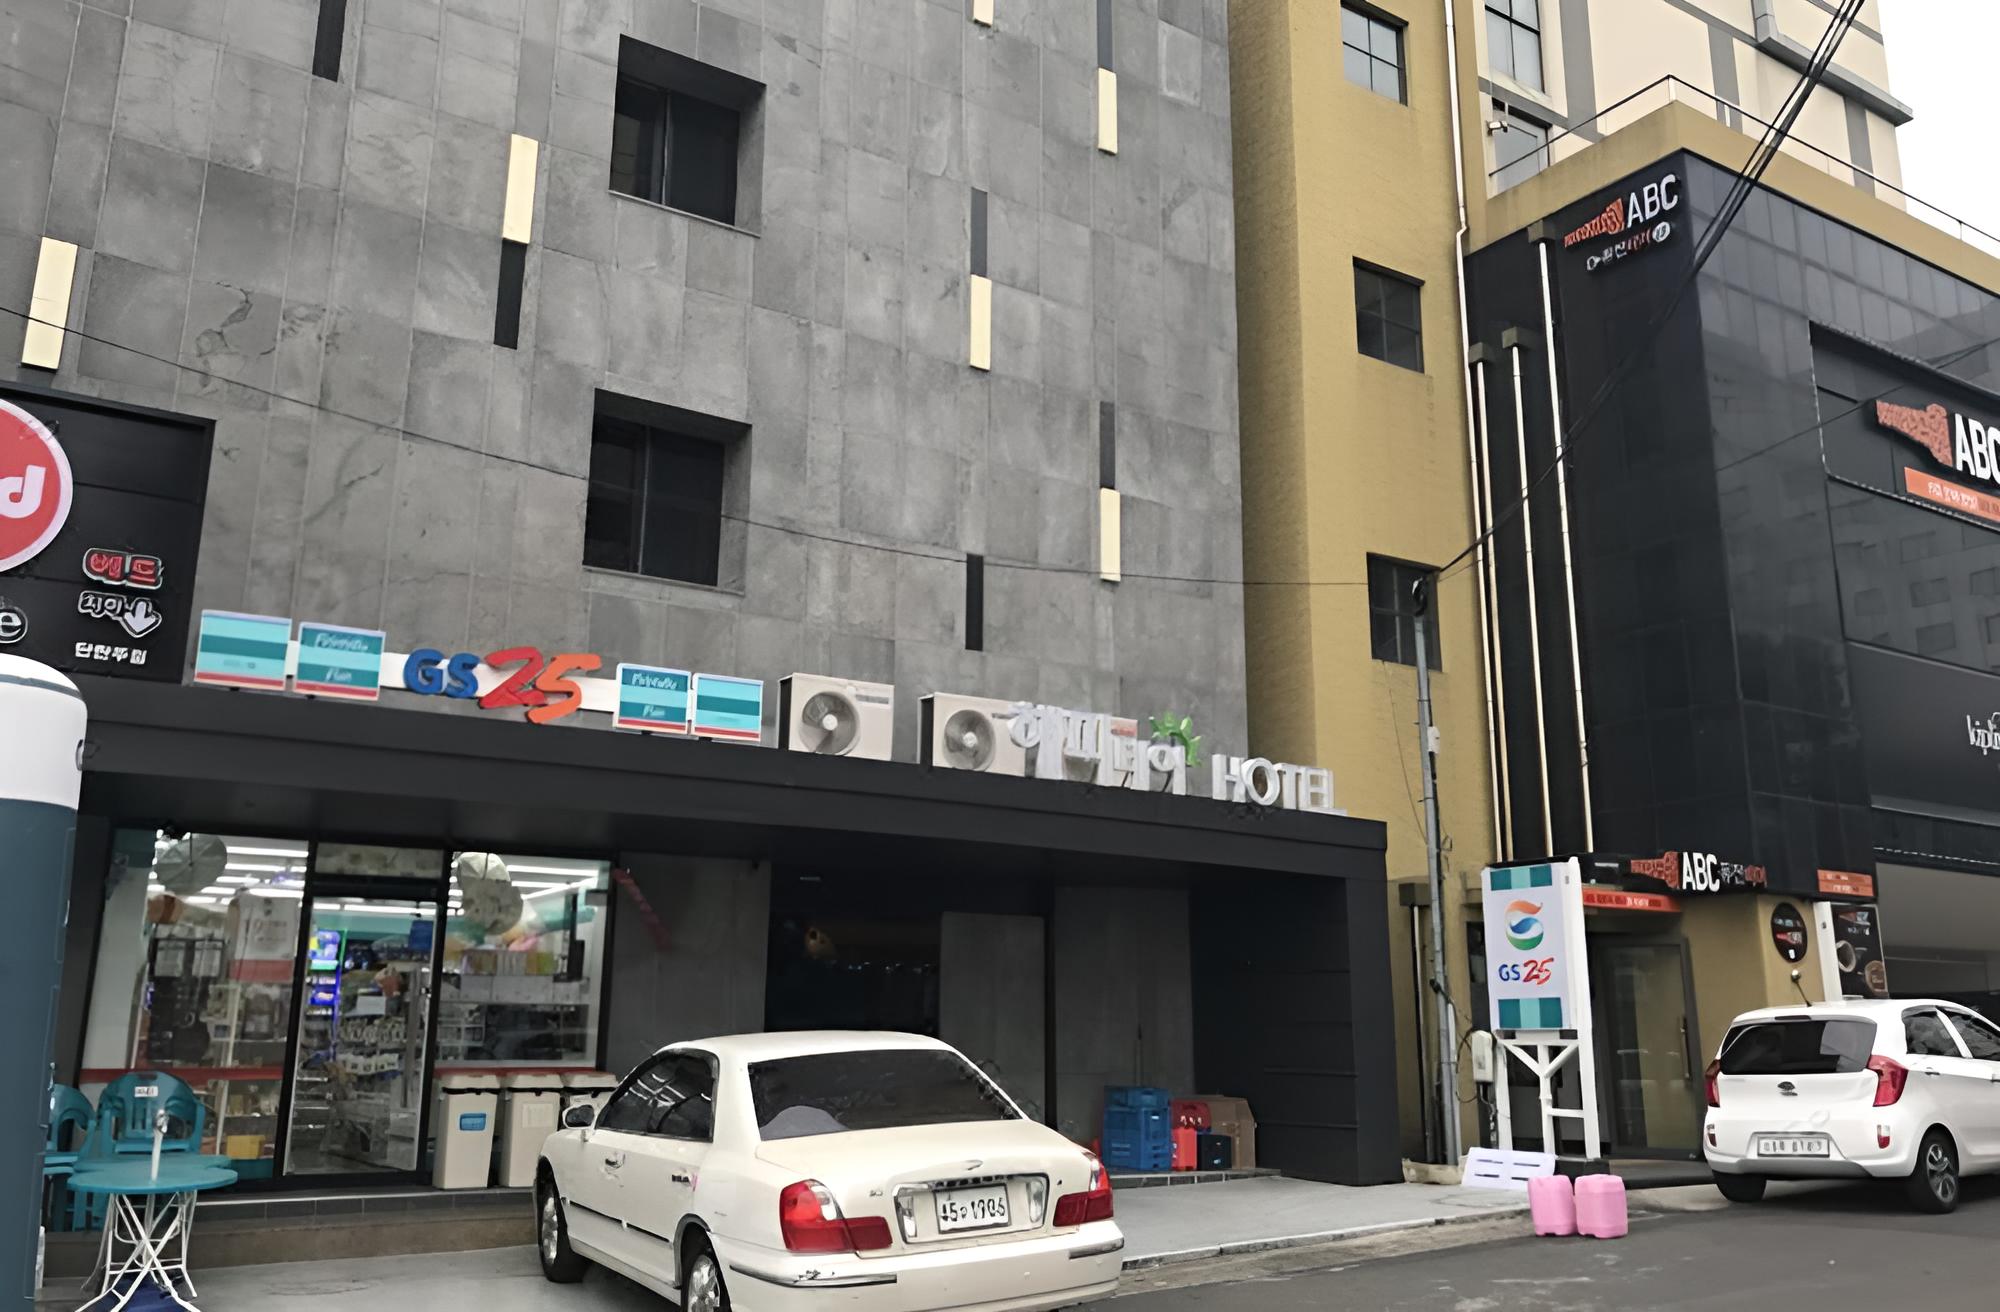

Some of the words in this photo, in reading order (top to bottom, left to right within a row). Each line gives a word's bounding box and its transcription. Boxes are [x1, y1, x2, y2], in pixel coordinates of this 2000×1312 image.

[1627, 173, 1678, 228] ABC
[403, 646, 601, 724] GS25
[1211, 753, 1347, 817] HOTEL
[1682, 851, 1720, 892] ABC
[1498, 957, 1555, 986] GS25
